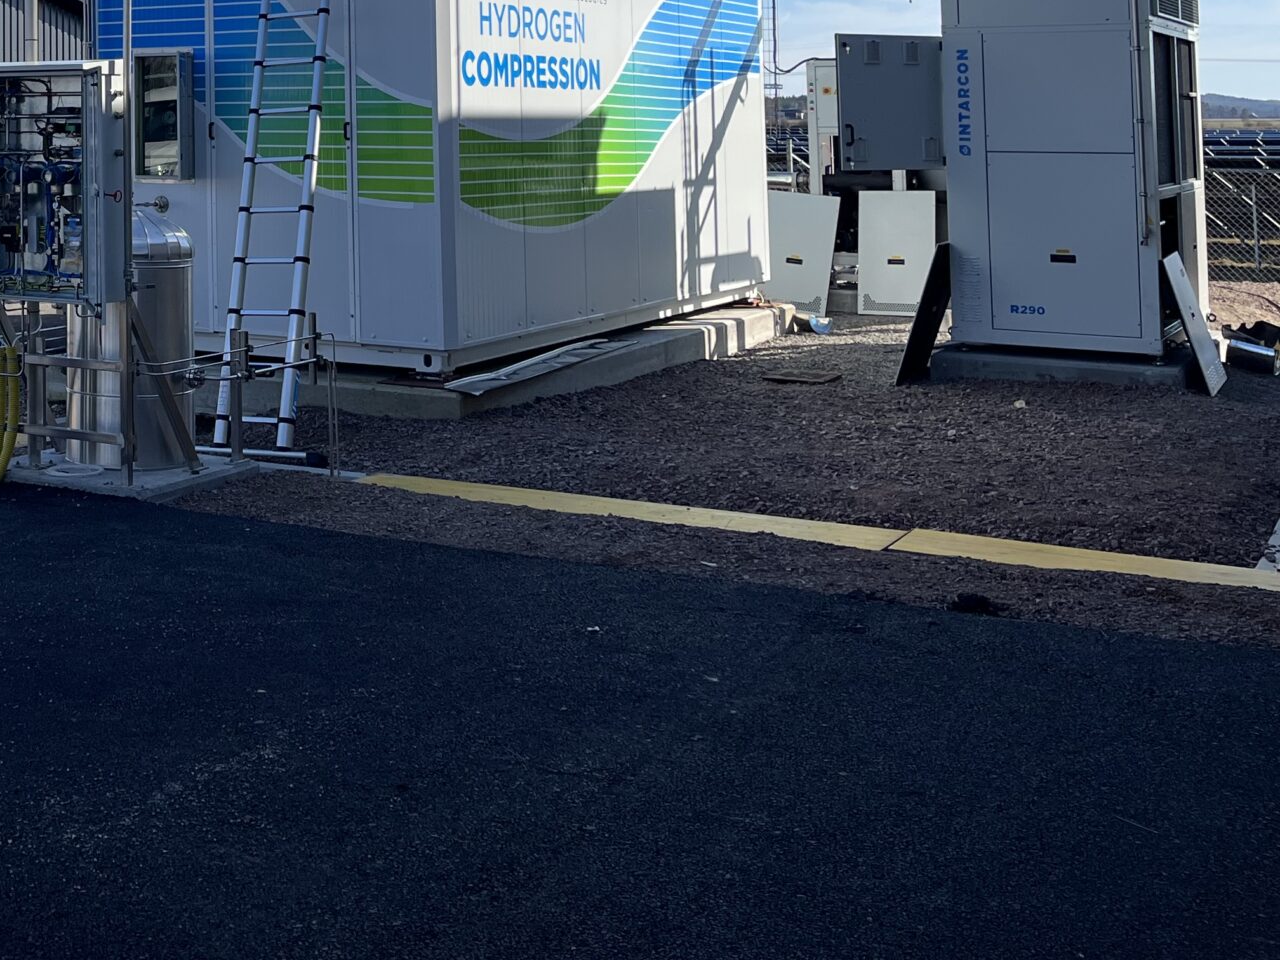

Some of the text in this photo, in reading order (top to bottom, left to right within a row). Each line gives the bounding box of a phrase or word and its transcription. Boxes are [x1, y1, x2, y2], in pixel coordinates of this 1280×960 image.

[479, 1, 586, 44] HYDROGEN
[461, 50, 601, 90] COMPRESSION
[956, 49, 971, 142] INTARCON
[1010, 304, 1046, 315] R290
